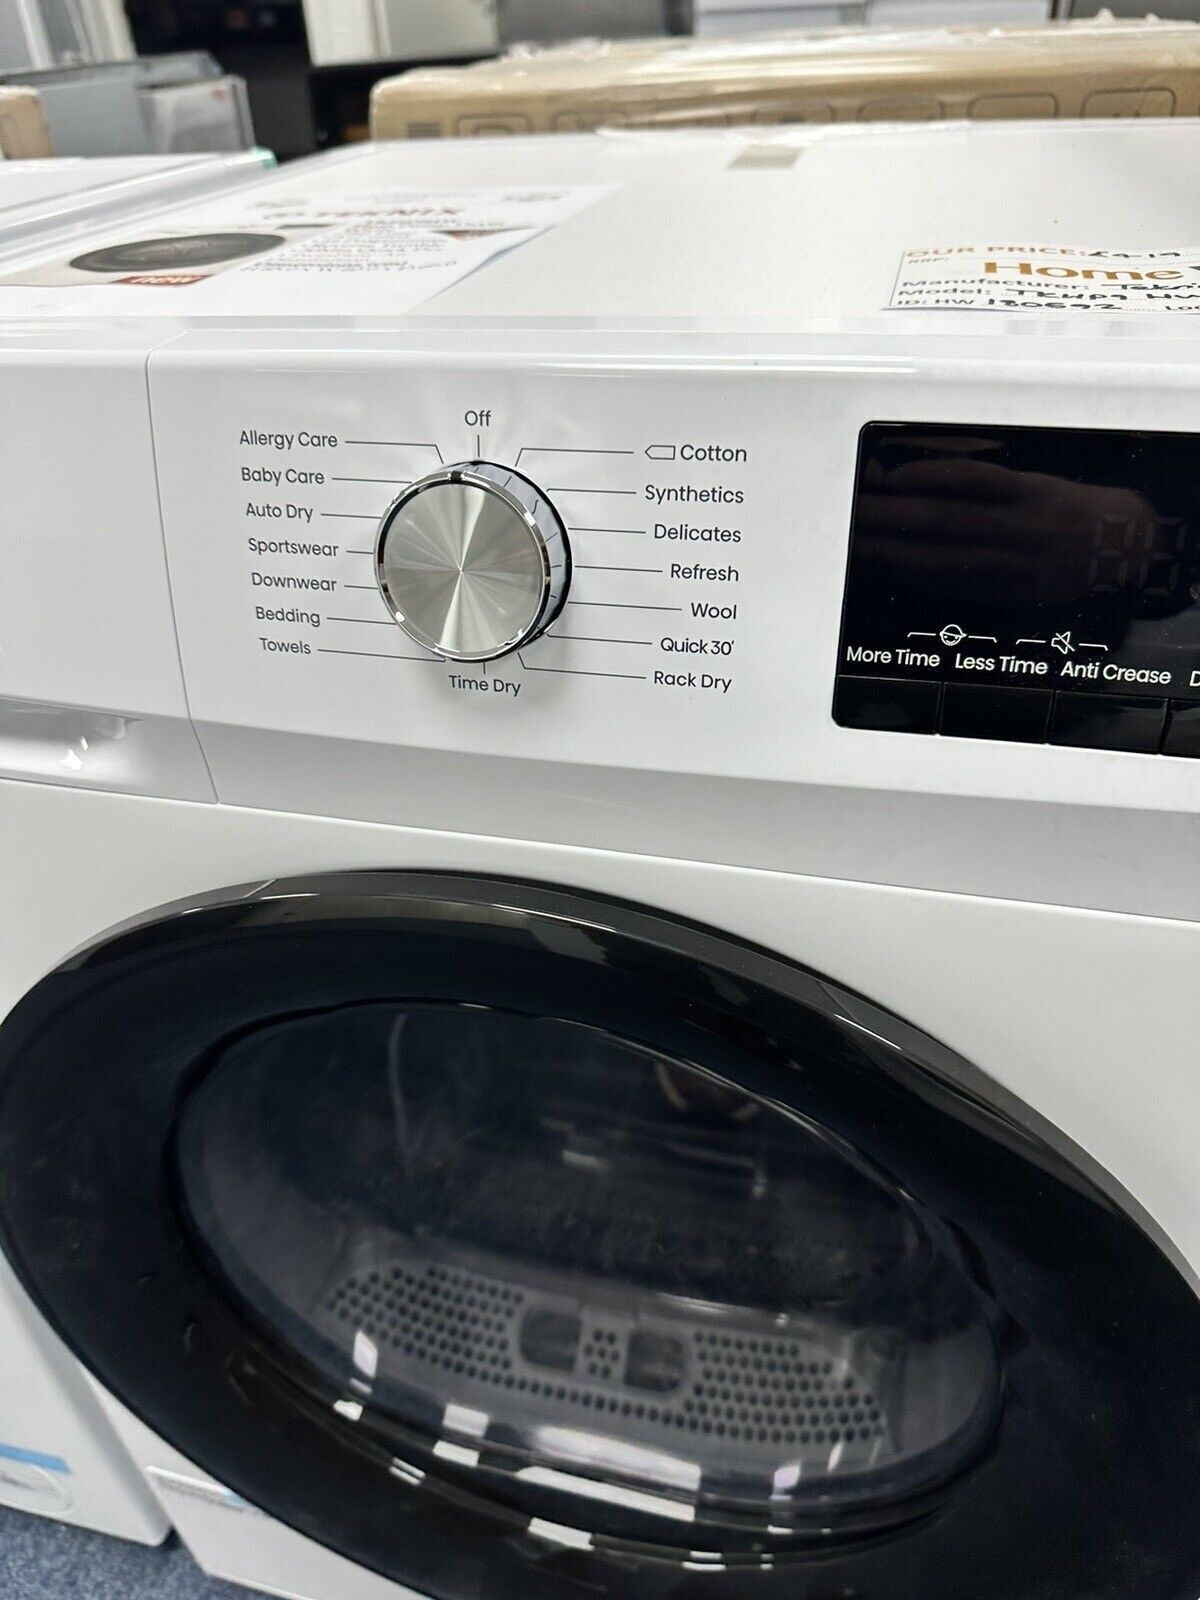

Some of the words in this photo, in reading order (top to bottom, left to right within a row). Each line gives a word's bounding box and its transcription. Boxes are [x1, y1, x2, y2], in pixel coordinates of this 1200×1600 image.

[906, 247, 975, 257] OUR
[984, 261, 1185, 281] Home
[898, 287, 991, 297] Model:
[902, 277, 1090, 290] Manufacturer:
[464, 409, 492, 428] Off
[239, 429, 295, 451] Allergy
[297, 431, 338, 448] Care
[680, 443, 748, 463] Cotton
[240, 466, 282, 487] Baby
[285, 468, 325, 485] Care
[644, 484, 744, 506] Synthetics
[245, 502, 282, 518] Auto
[286, 503, 314, 524] Dry
[653, 523, 742, 543] Delicates
[248, 537, 340, 557] Sportswear
[251, 571, 338, 592] Downwear
[670, 563, 740, 582] Refresh
[255, 606, 321, 628] Bedding
[690, 602, 738, 620] Wool
[258, 637, 312, 655] Towels
[846, 645, 892, 665] More
[895, 648, 941, 668] Time
[954, 652, 996, 672] Less
[999, 655, 1049, 676] Time
[653, 670, 697, 688] Rack
[700, 673, 733, 693] Dry
[1059, 660, 1100, 680] Anti
[1102, 663, 1173, 686] Crease
[448, 674, 489, 692] Time
[493, 678, 522, 698] Dry
